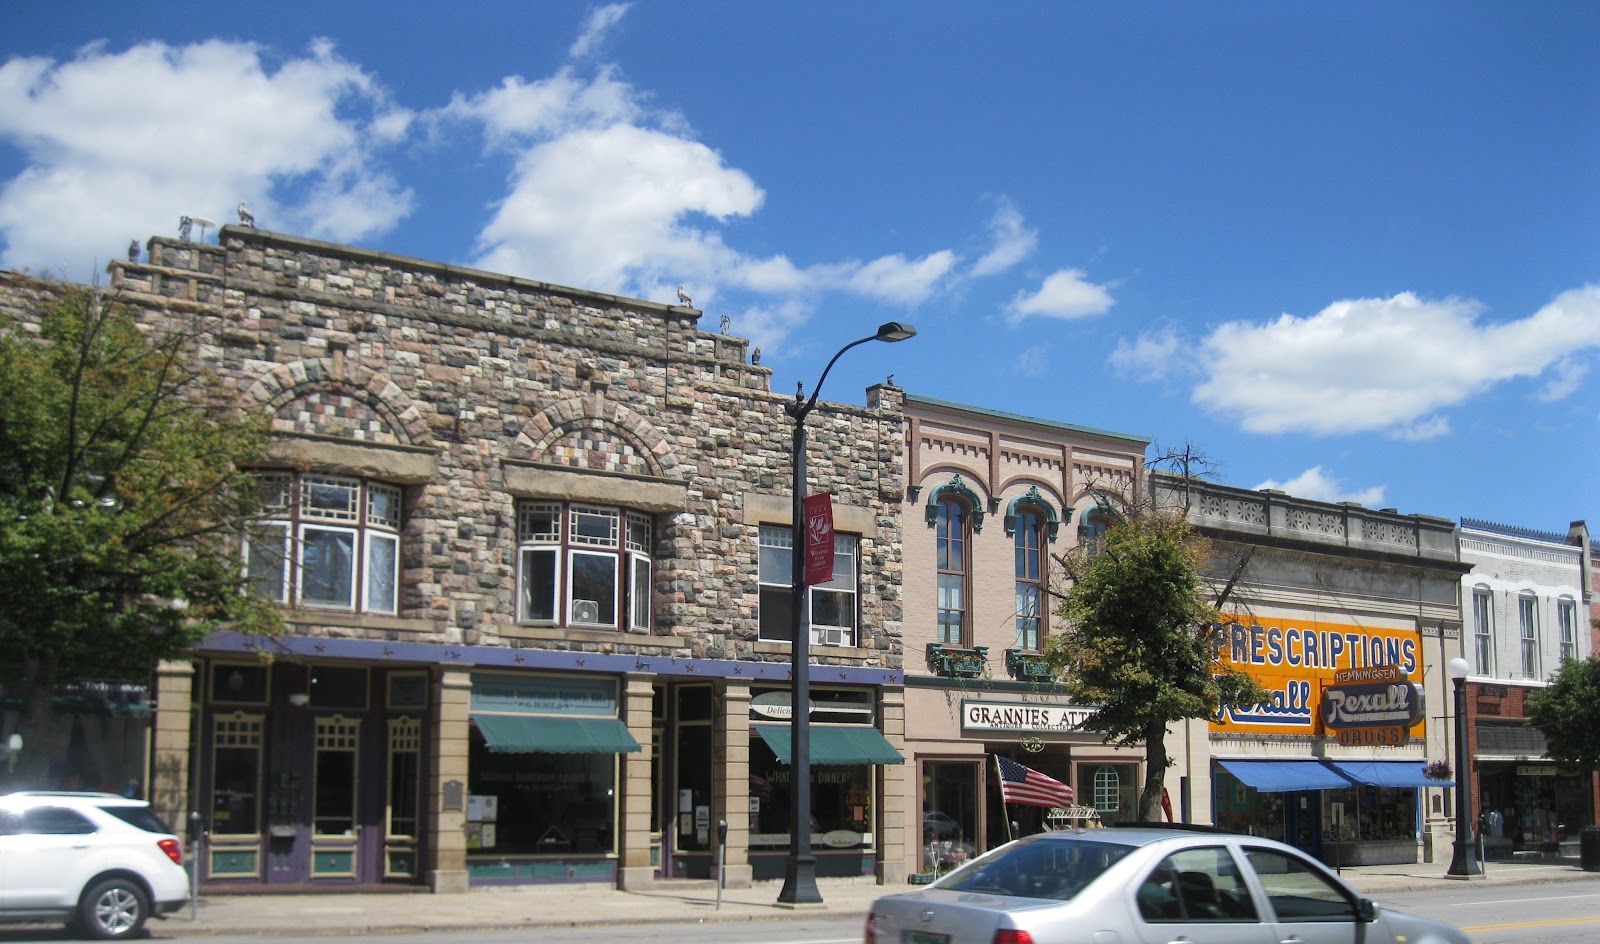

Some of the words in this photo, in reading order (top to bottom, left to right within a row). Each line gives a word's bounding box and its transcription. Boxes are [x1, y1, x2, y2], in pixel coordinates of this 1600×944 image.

[1211, 622, 1416, 674] PRESCRIPTIONS
[1336, 668, 1396, 682] HEMMINGSEN
[766, 706, 792, 715] Delicio
[1327, 684, 1410, 723] Rexall
[970, 707, 1049, 724] GRANNIES
[1061, 712, 1094, 725] ATT
[1032, 723, 1075, 731] COLLECTIBLE
[1340, 728, 1399, 745] DRUGS
[765, 771, 791, 783] WHAT
